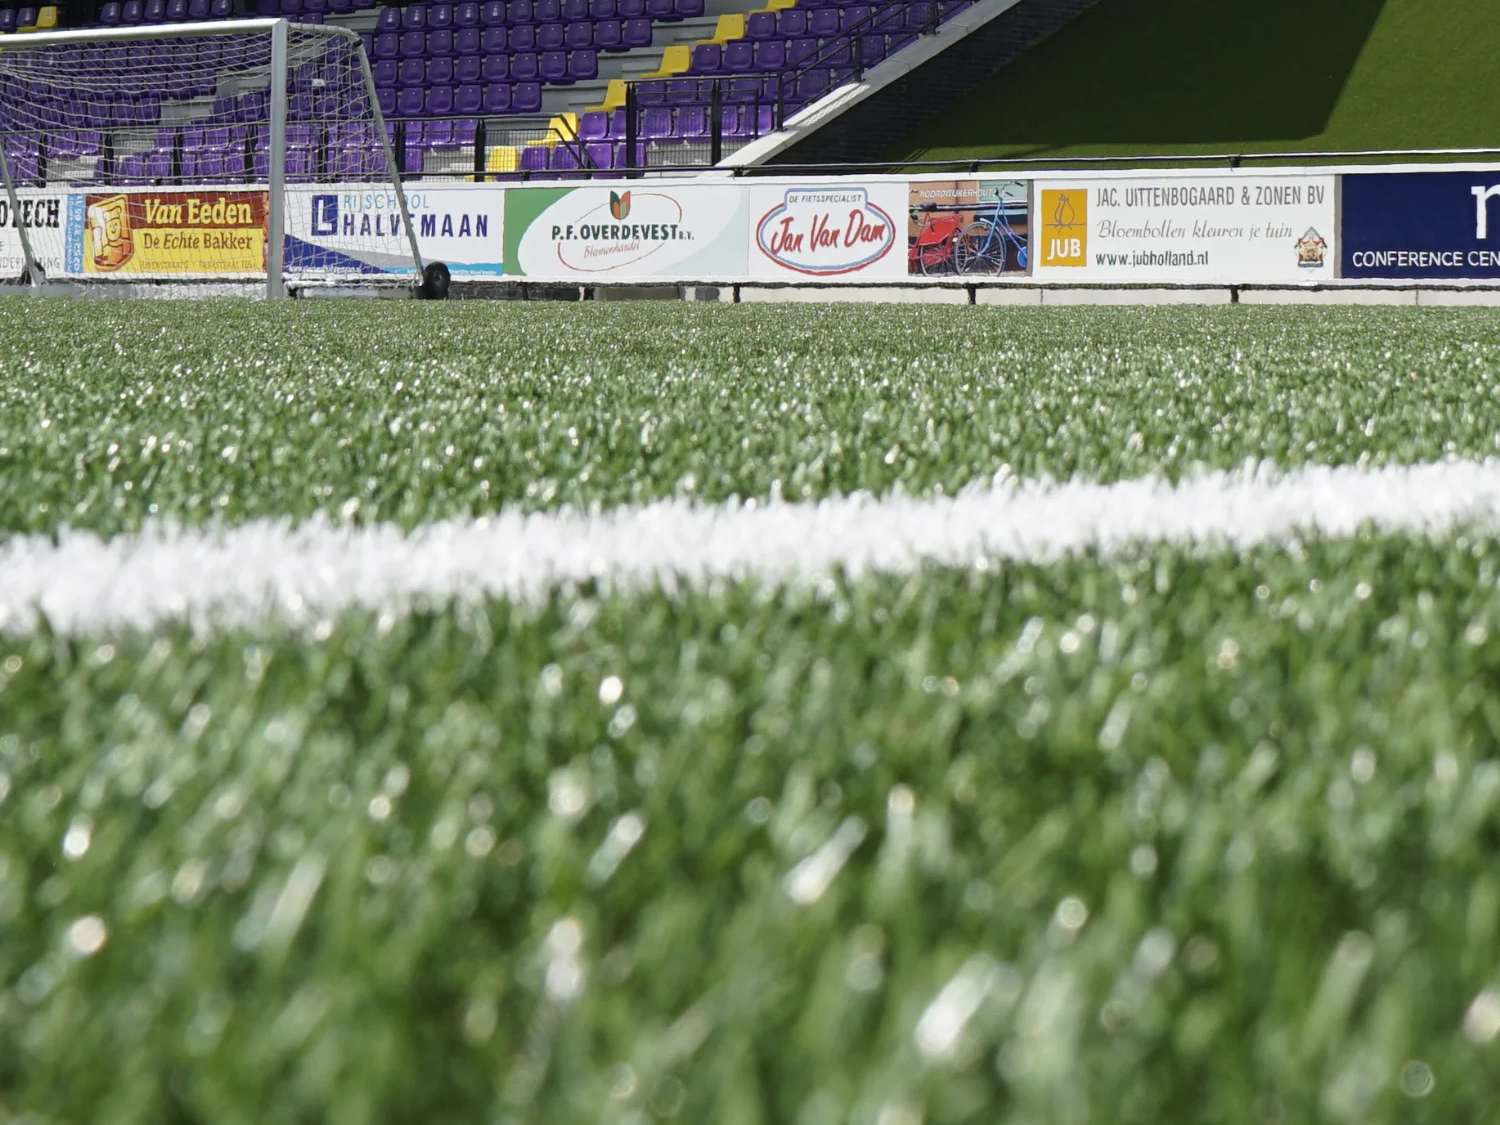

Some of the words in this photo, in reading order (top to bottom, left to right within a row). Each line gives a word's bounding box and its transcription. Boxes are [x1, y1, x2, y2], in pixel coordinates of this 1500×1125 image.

[789, 195, 799, 203] DE
[801, 194, 862, 203] FIETSSPECIALIST
[1096, 187, 1121, 207] JAC.
[1125, 186, 1235, 207] UITTENBOGAARD
[1241, 185, 1251, 206] &
[1255, 185, 1301, 206] ZONEN
[1307, 185, 1325, 205] BV
[144, 198, 183, 224] Van
[186, 197, 253, 224] Eeden
[551, 225, 577, 241] P.F.
[580, 224, 678, 241] OVERDEVEST
[678, 231, 695, 241] B.V.
[770, 216, 804, 254] Jan
[810, 213, 841, 252] Van
[844, 208, 886, 248] Dam
[1096, 219, 1186, 239] Bloembollen
[1192, 219, 1244, 238] kleuren
[1249, 223, 1261, 241] je
[1265, 222, 1293, 239] tuin
[143, 233, 160, 249] De
[162, 231, 200, 250] Echte
[203, 232, 253, 250] Bakker
[1047, 238, 1082, 261] JUB
[1095, 250, 1209, 267] www.jubholland.nl
[1352, 250, 1464, 267] CONFERENCE
